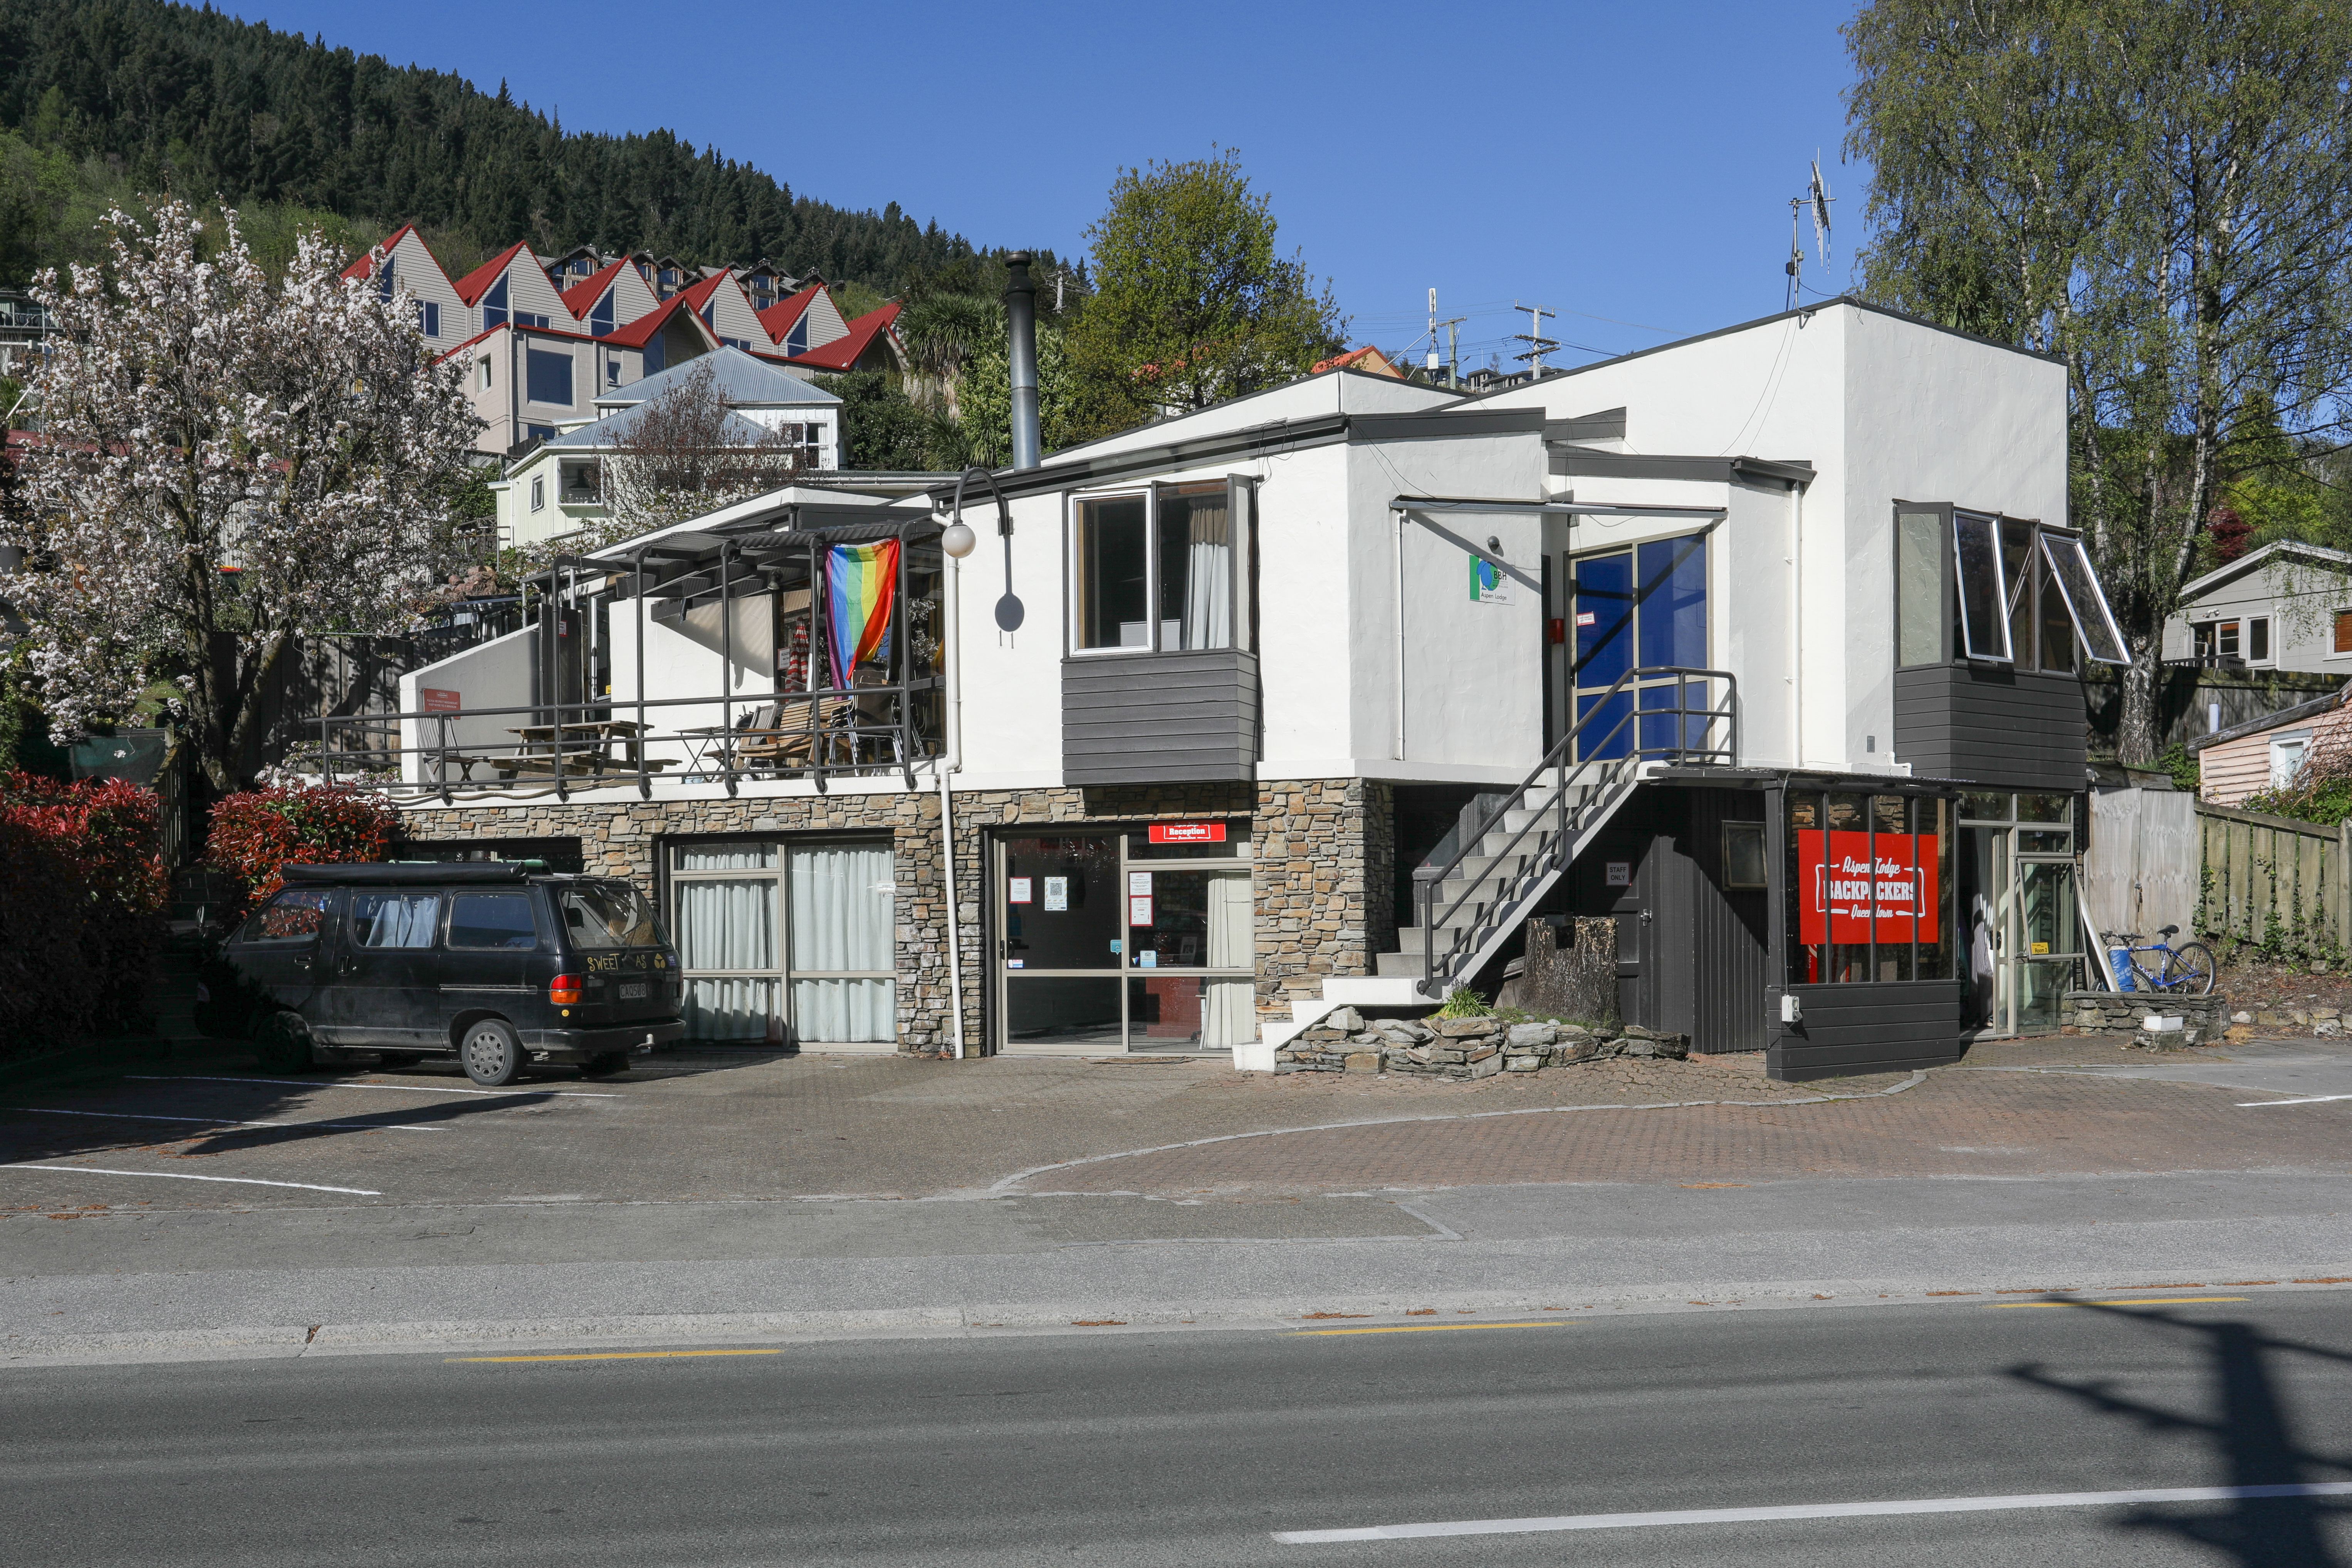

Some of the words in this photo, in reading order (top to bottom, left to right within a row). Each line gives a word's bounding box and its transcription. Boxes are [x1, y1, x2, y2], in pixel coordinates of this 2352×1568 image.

[1494, 571, 1507, 580] BBH
[1169, 828, 1205, 836] Reception
[1842, 856, 1870, 877] Aspen
[1875, 857, 1900, 878] Lodge
[1851, 904, 1894, 920] Queetown
[587, 953, 619, 972] SWEET
[636, 955, 647, 969] AS
[620, 984, 646, 997] CAQ508
